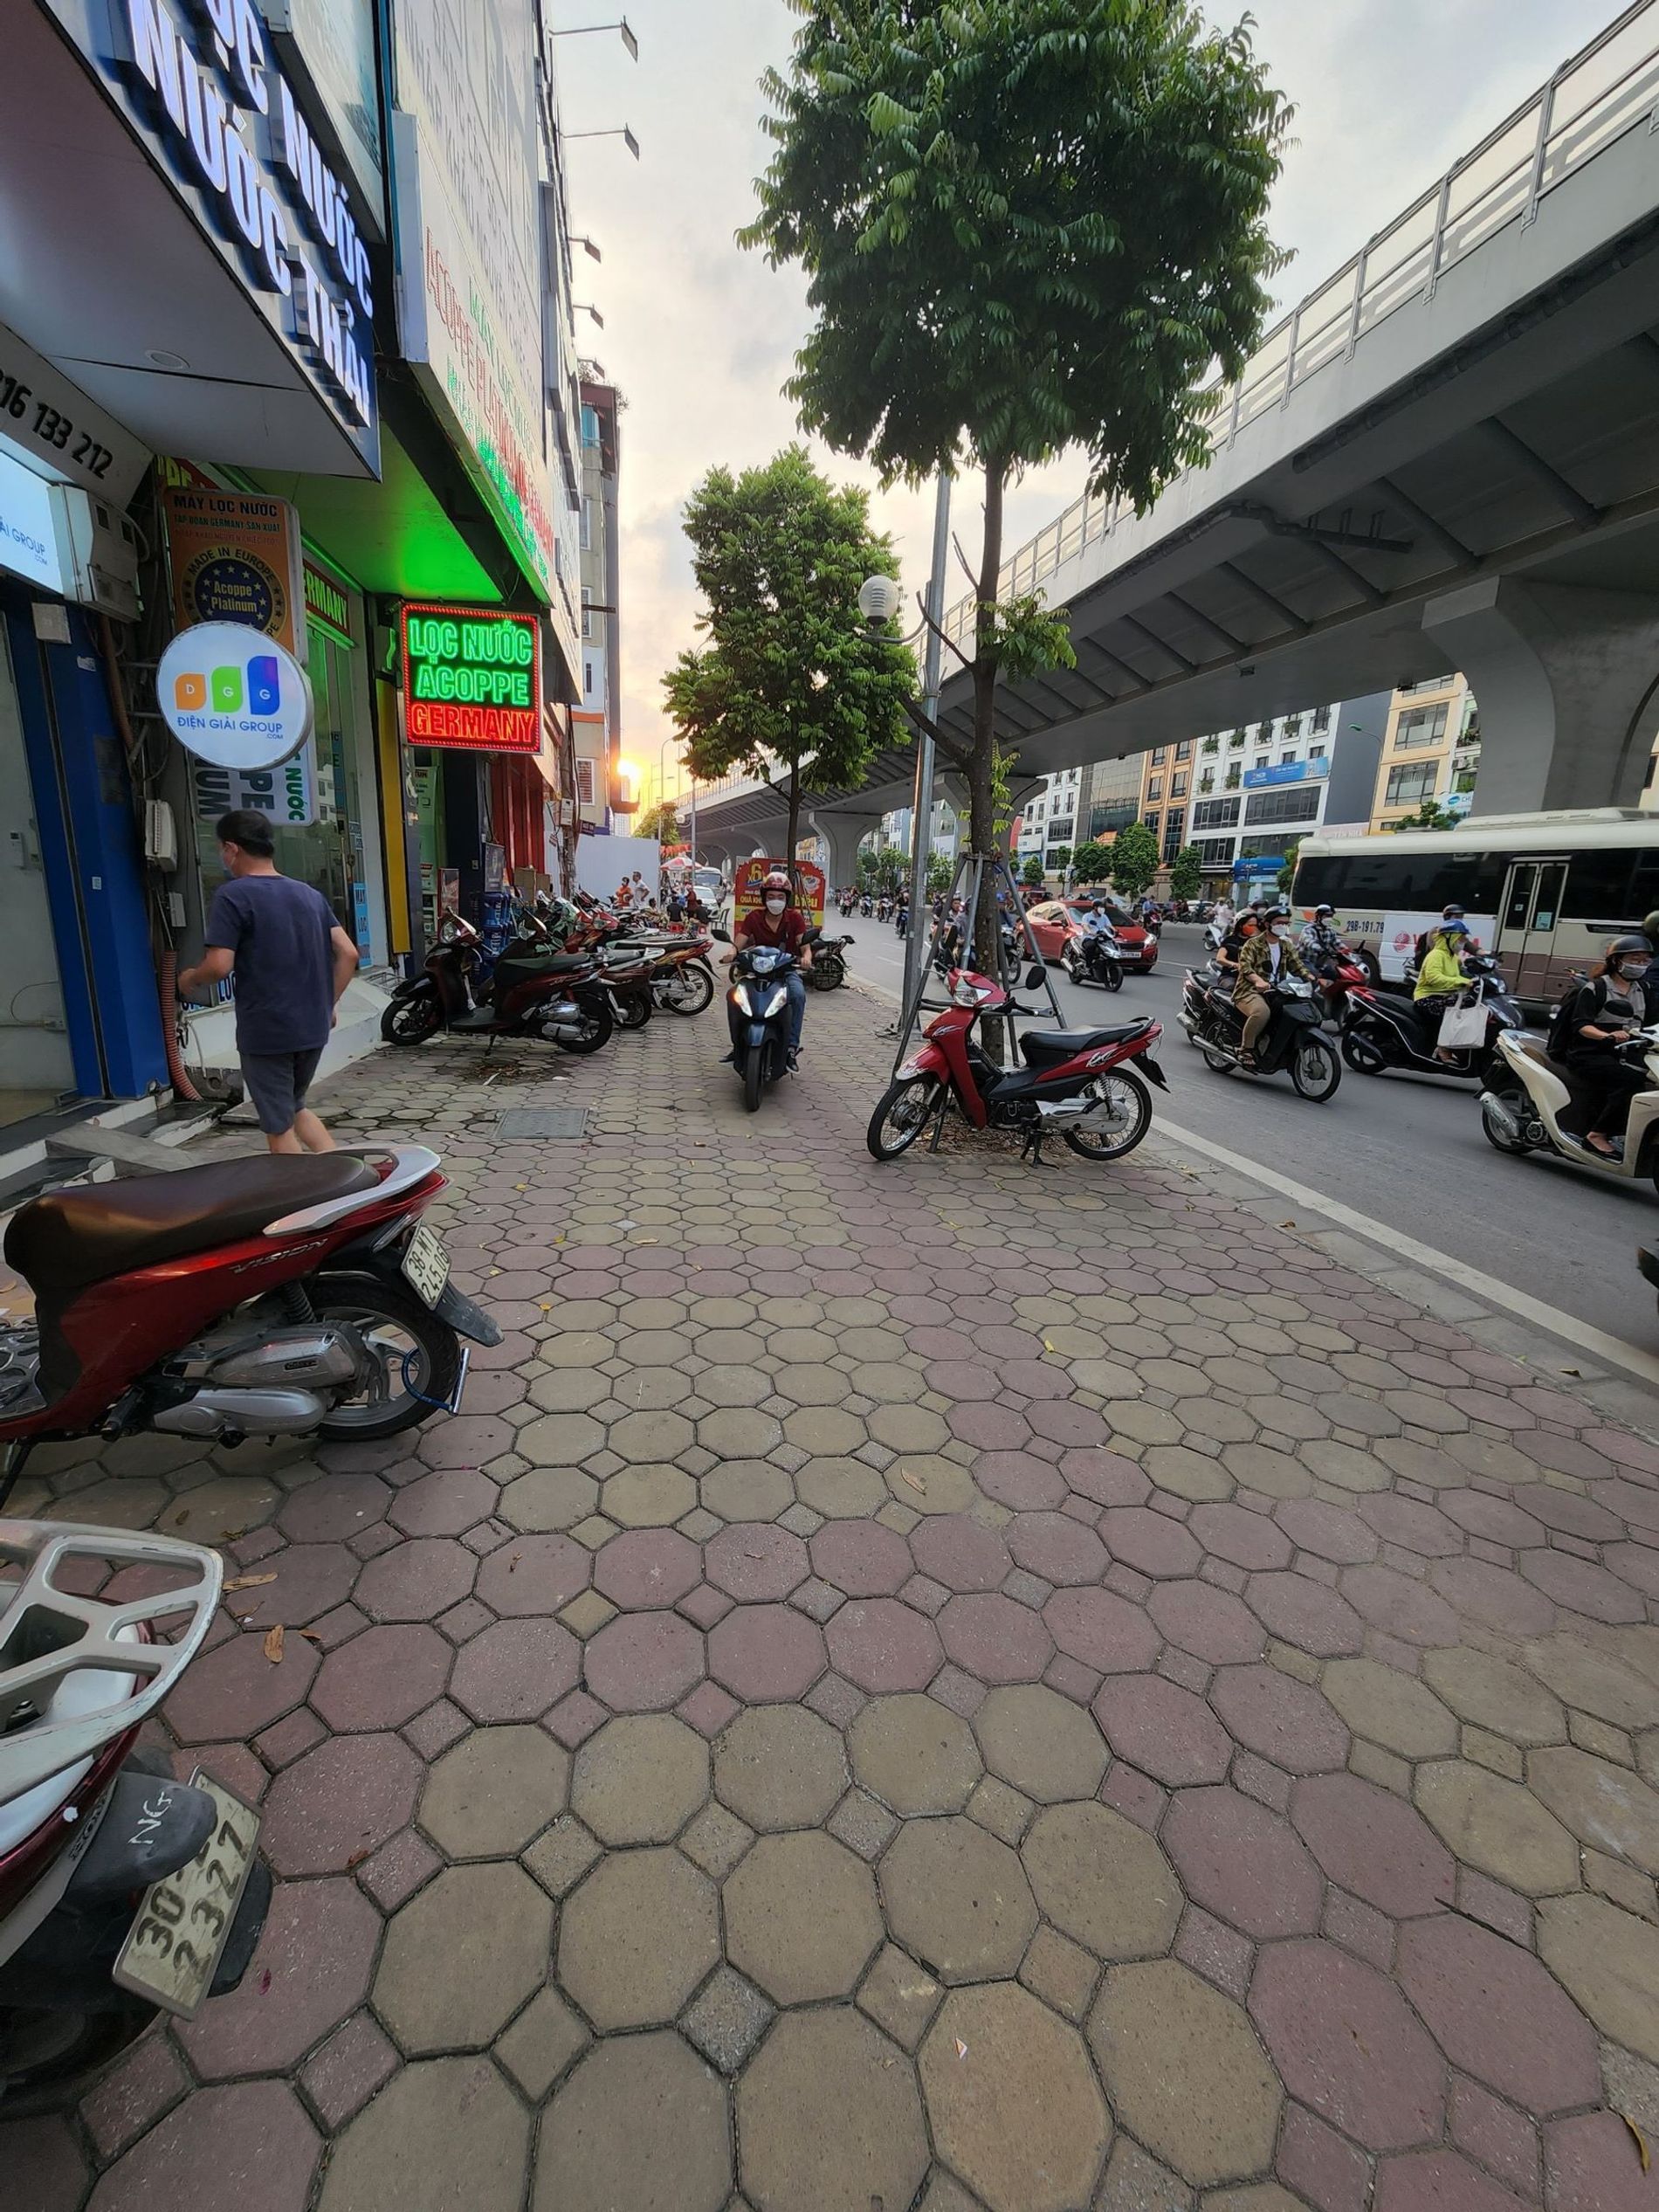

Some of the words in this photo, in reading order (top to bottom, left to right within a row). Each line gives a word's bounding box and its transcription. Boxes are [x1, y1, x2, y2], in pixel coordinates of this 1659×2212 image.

[128, 0, 293, 296] NƯỚC
[299, 247, 371, 428] THẢI
[279, 72, 374, 320] NƯỚC
[32, 402, 73, 450] 133
[72, 431, 113, 479] 212
[210, 499, 236, 515] LỌC
[11, 527, 45, 555] GROUP
[188, 549, 215, 576] MADE
[218, 547, 231, 556] IN
[235, 549, 276, 582] EUROPE
[211, 597, 257, 613] Platinum
[213, 581, 252, 596] Acoppe
[409, 617, 458, 664] LỌC
[463, 619, 533, 665] NƯỚC
[416, 665, 530, 706] ACOPPE
[177, 715, 205, 729] ĐIỆN
[209, 716, 236, 730] GIẢI
[240, 721, 283, 733] GROUP
[411, 704, 535, 742] GERMANY
[285, 768, 306, 821] NƯỚC
[1346, 920, 1384, 934] 29B-191.79
[228, 1238, 328, 1273] VISION
[422, 1246, 450, 1302] 245.06
[136, 1836, 214, 1959] 30-
[174, 1820, 248, 1978] 2327
